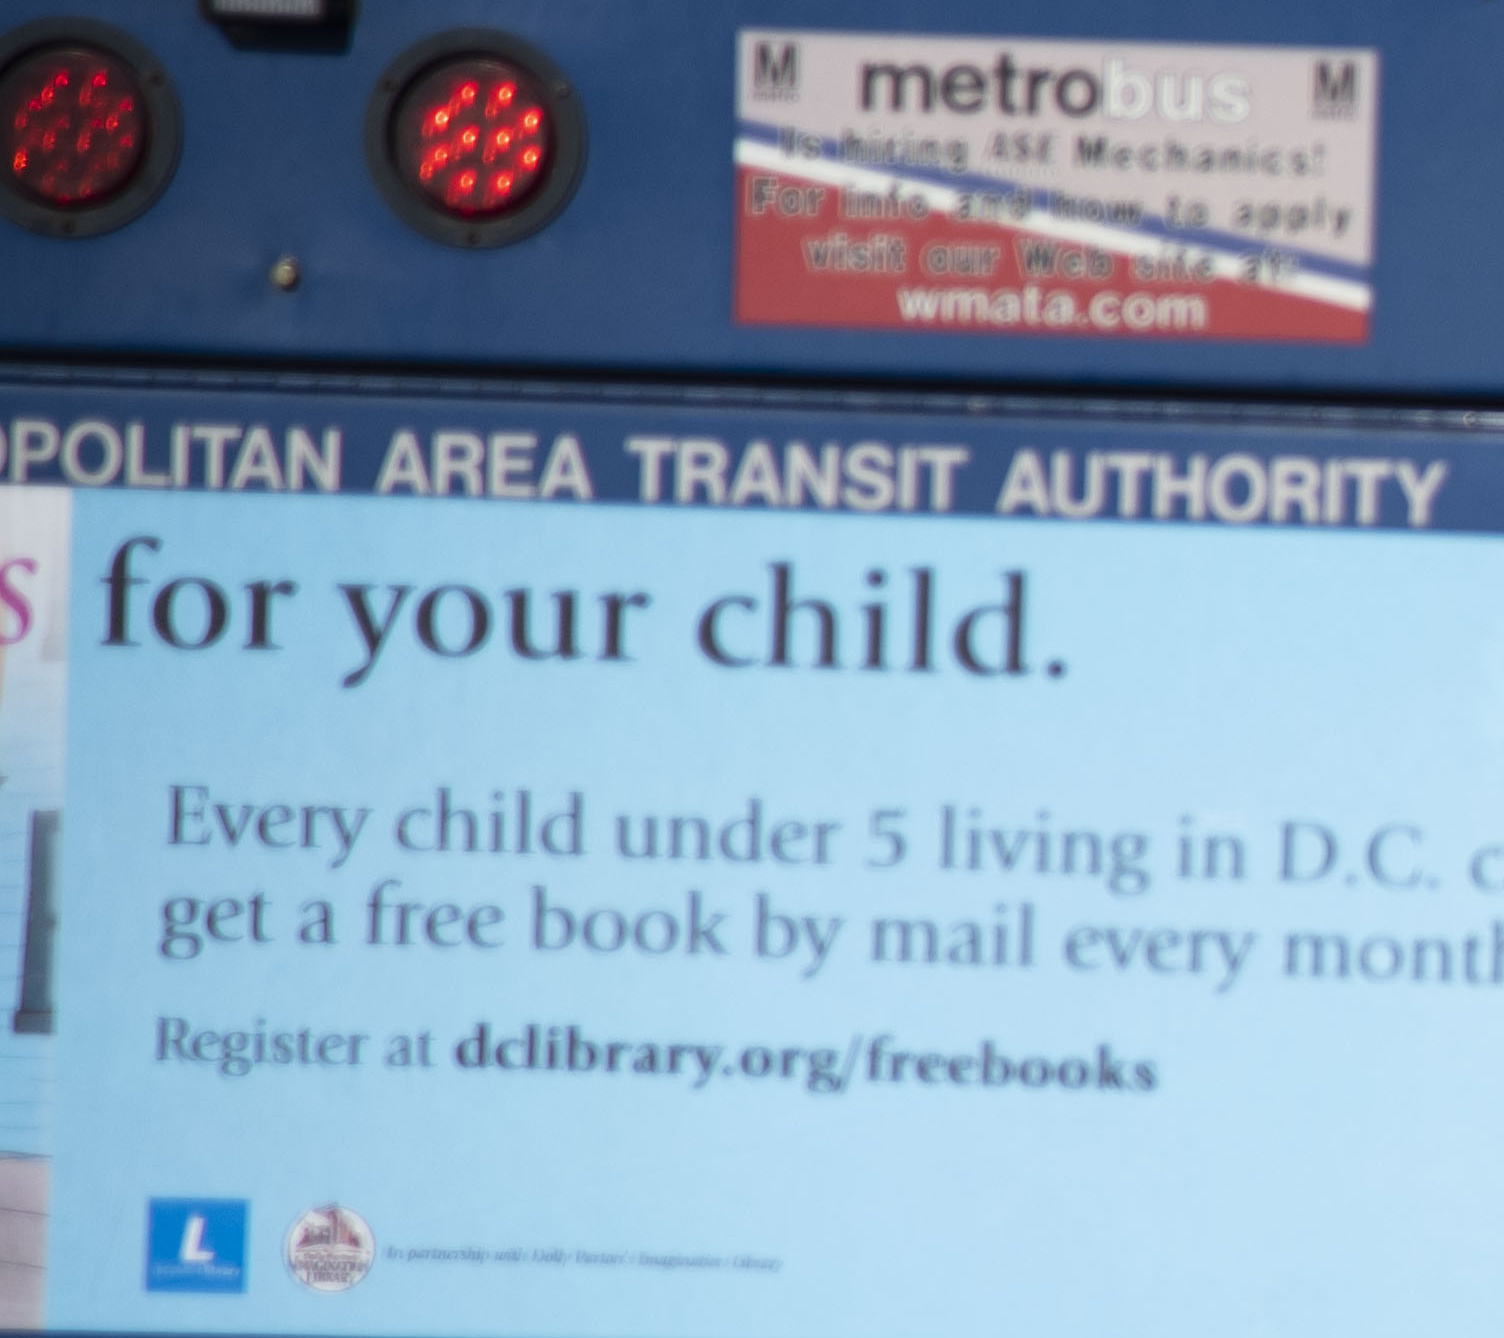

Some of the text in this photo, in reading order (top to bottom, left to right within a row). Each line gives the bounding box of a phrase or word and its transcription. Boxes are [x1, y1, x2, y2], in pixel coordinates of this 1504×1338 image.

[754, 42, 797, 88] M
[861, 51, 1251, 123] metrobus
[839, 127, 970, 173] hiring
[749, 176, 1352, 240] For info and how to apply
[804, 235, 907, 273] visit
[921, 242, 1001, 276] our
[1018, 237, 1113, 279] Web
[1132, 246, 1214, 281] site
[899, 285, 1208, 329] wmata.com
[0, 418, 1448, 529] POLITAN AREA TRANSIT AUTHORITY
[98, 535, 1068, 690] for your child.
[166, 783, 373, 869] Every
[392, 785, 588, 859] child
[614, 798, 844, 865] under
[864, 806, 911, 873] 5
[935, 803, 1152, 896] living
[1175, 814, 1248, 883] in
[1277, 819, 1443, 892] D.C.
[157, 886, 275, 961] get
[298, 901, 338, 946] a
[365, 878, 507, 951] free
[530, 884, 730, 959] book
[751, 890, 846, 980] by
[867, 903, 1038, 969] mail
[1062, 918, 1258, 994] every
[154, 1014, 1160, 1096] Register at dclibrary.org/freebooks
[179, 1214, 216, 1263] L
